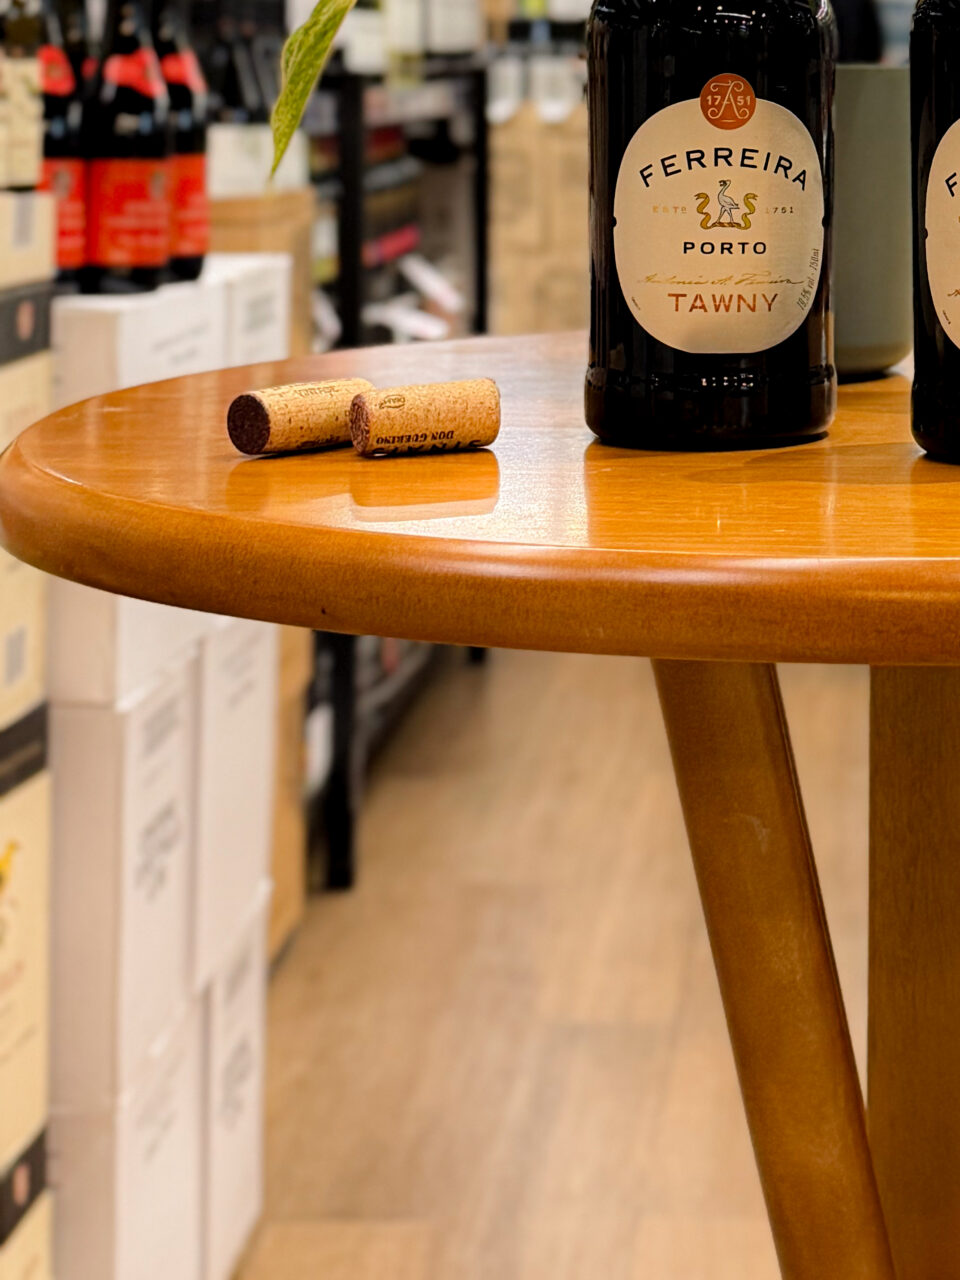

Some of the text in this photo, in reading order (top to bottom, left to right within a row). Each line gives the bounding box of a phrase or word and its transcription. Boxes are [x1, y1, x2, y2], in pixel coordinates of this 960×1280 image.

[639, 147, 808, 191] FERREIRA
[683, 241, 767, 255] PORTO
[667, 293, 779, 313] TAWNY
[375, 430, 455, 445] DON GUERINO
